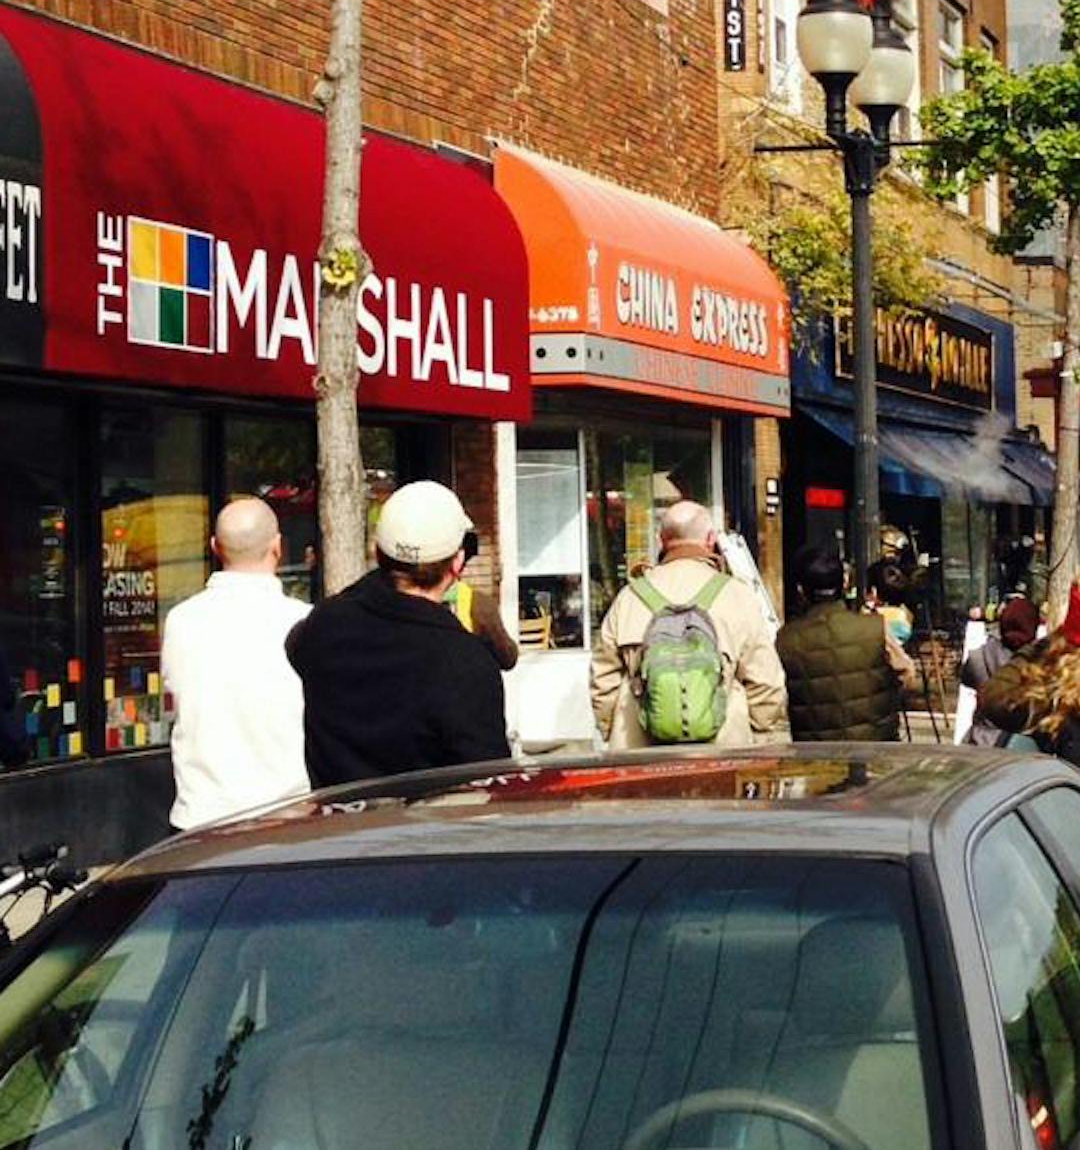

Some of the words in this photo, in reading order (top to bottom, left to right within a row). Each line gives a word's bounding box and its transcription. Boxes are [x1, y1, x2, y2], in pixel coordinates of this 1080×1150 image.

[0, 179, 42, 304] ET
[97, 211, 123, 335] THE
[216, 240, 511, 393] MASHALL
[616, 261, 680, 337] CHINA
[690, 283, 768, 359] EXPRESS
[103, 570, 155, 597] ASING
